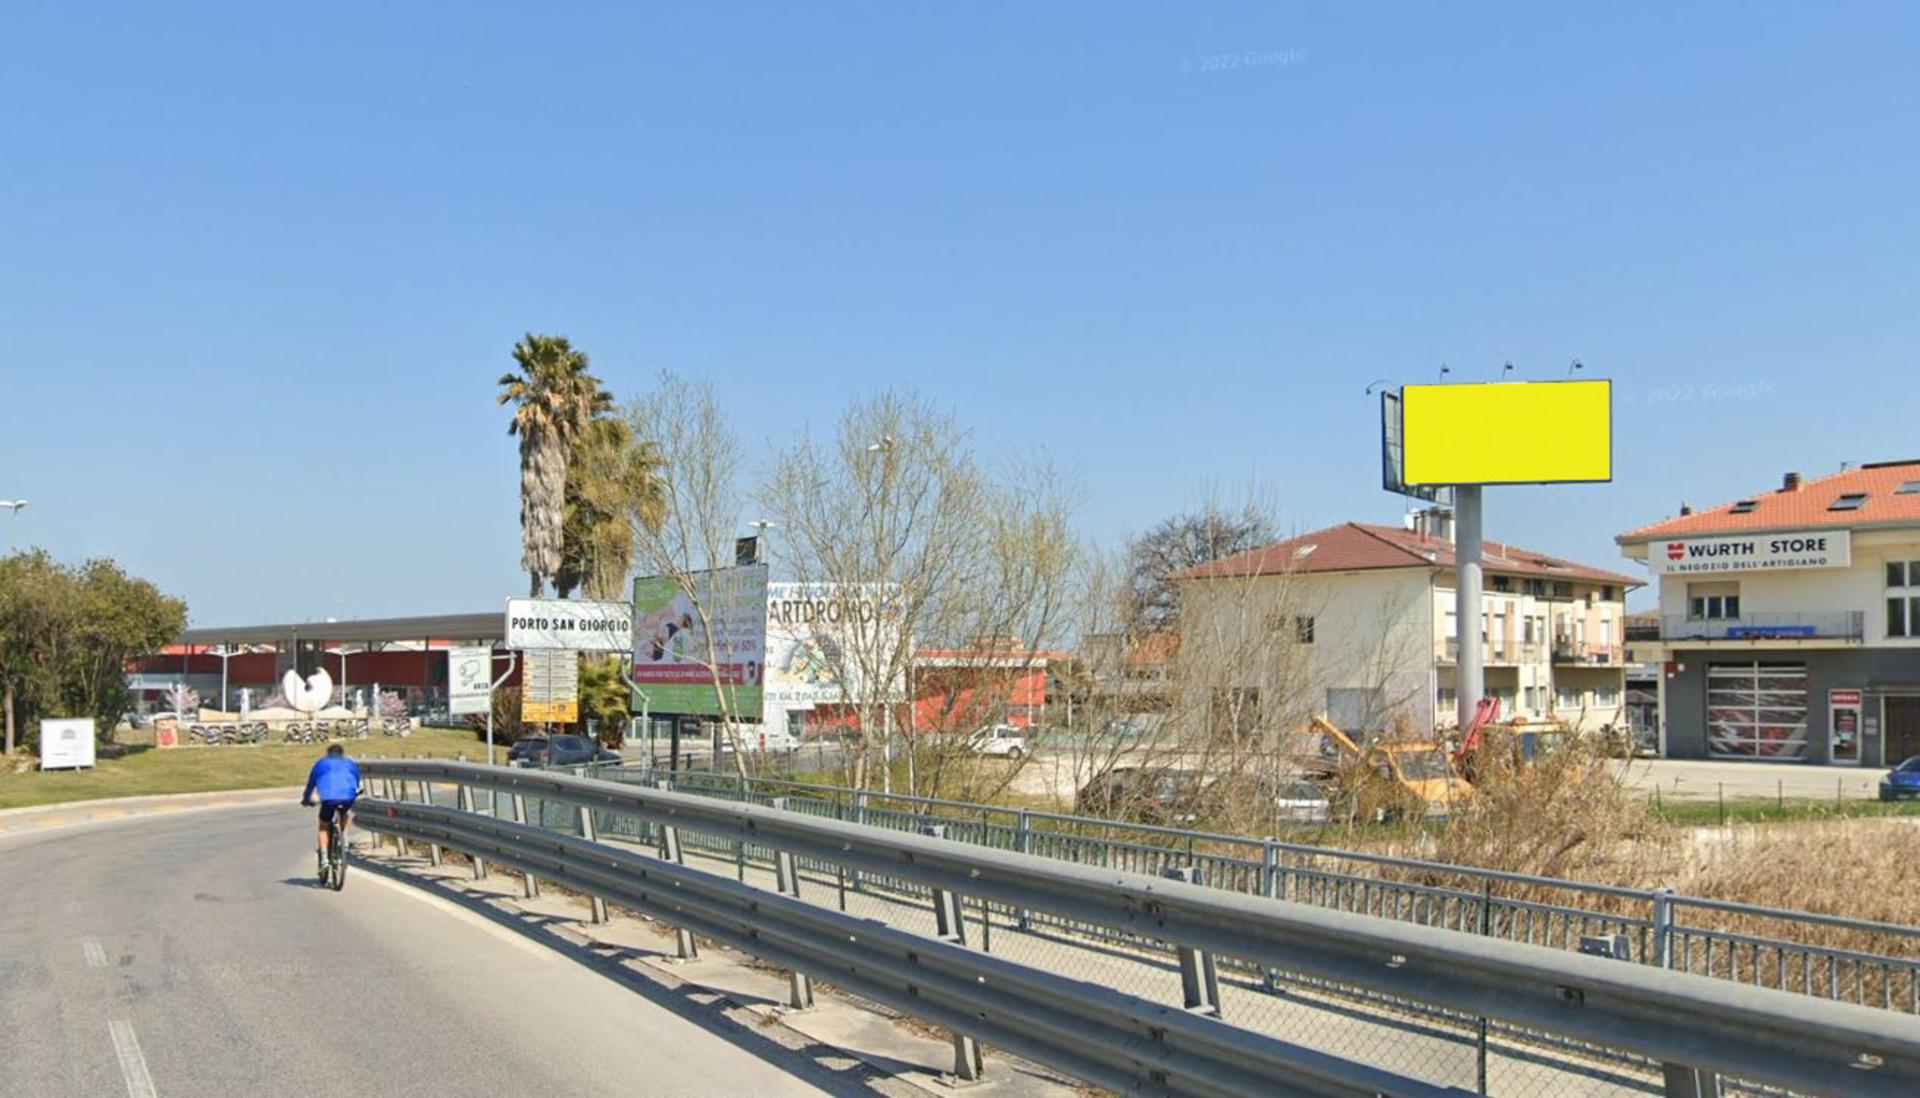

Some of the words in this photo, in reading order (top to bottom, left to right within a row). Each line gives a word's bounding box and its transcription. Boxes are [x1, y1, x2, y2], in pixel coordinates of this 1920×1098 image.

[1770, 538, 1827, 553] STORE
[1666, 564, 1676, 572] IL
[1679, 562, 1729, 571] NEGOZIO
[1732, 557, 1828, 569] DELL'ARTIGIANO
[511, 617, 549, 630] PORTO
[552, 618, 575, 631] SAN
[579, 619, 629, 632] GIORGIO
